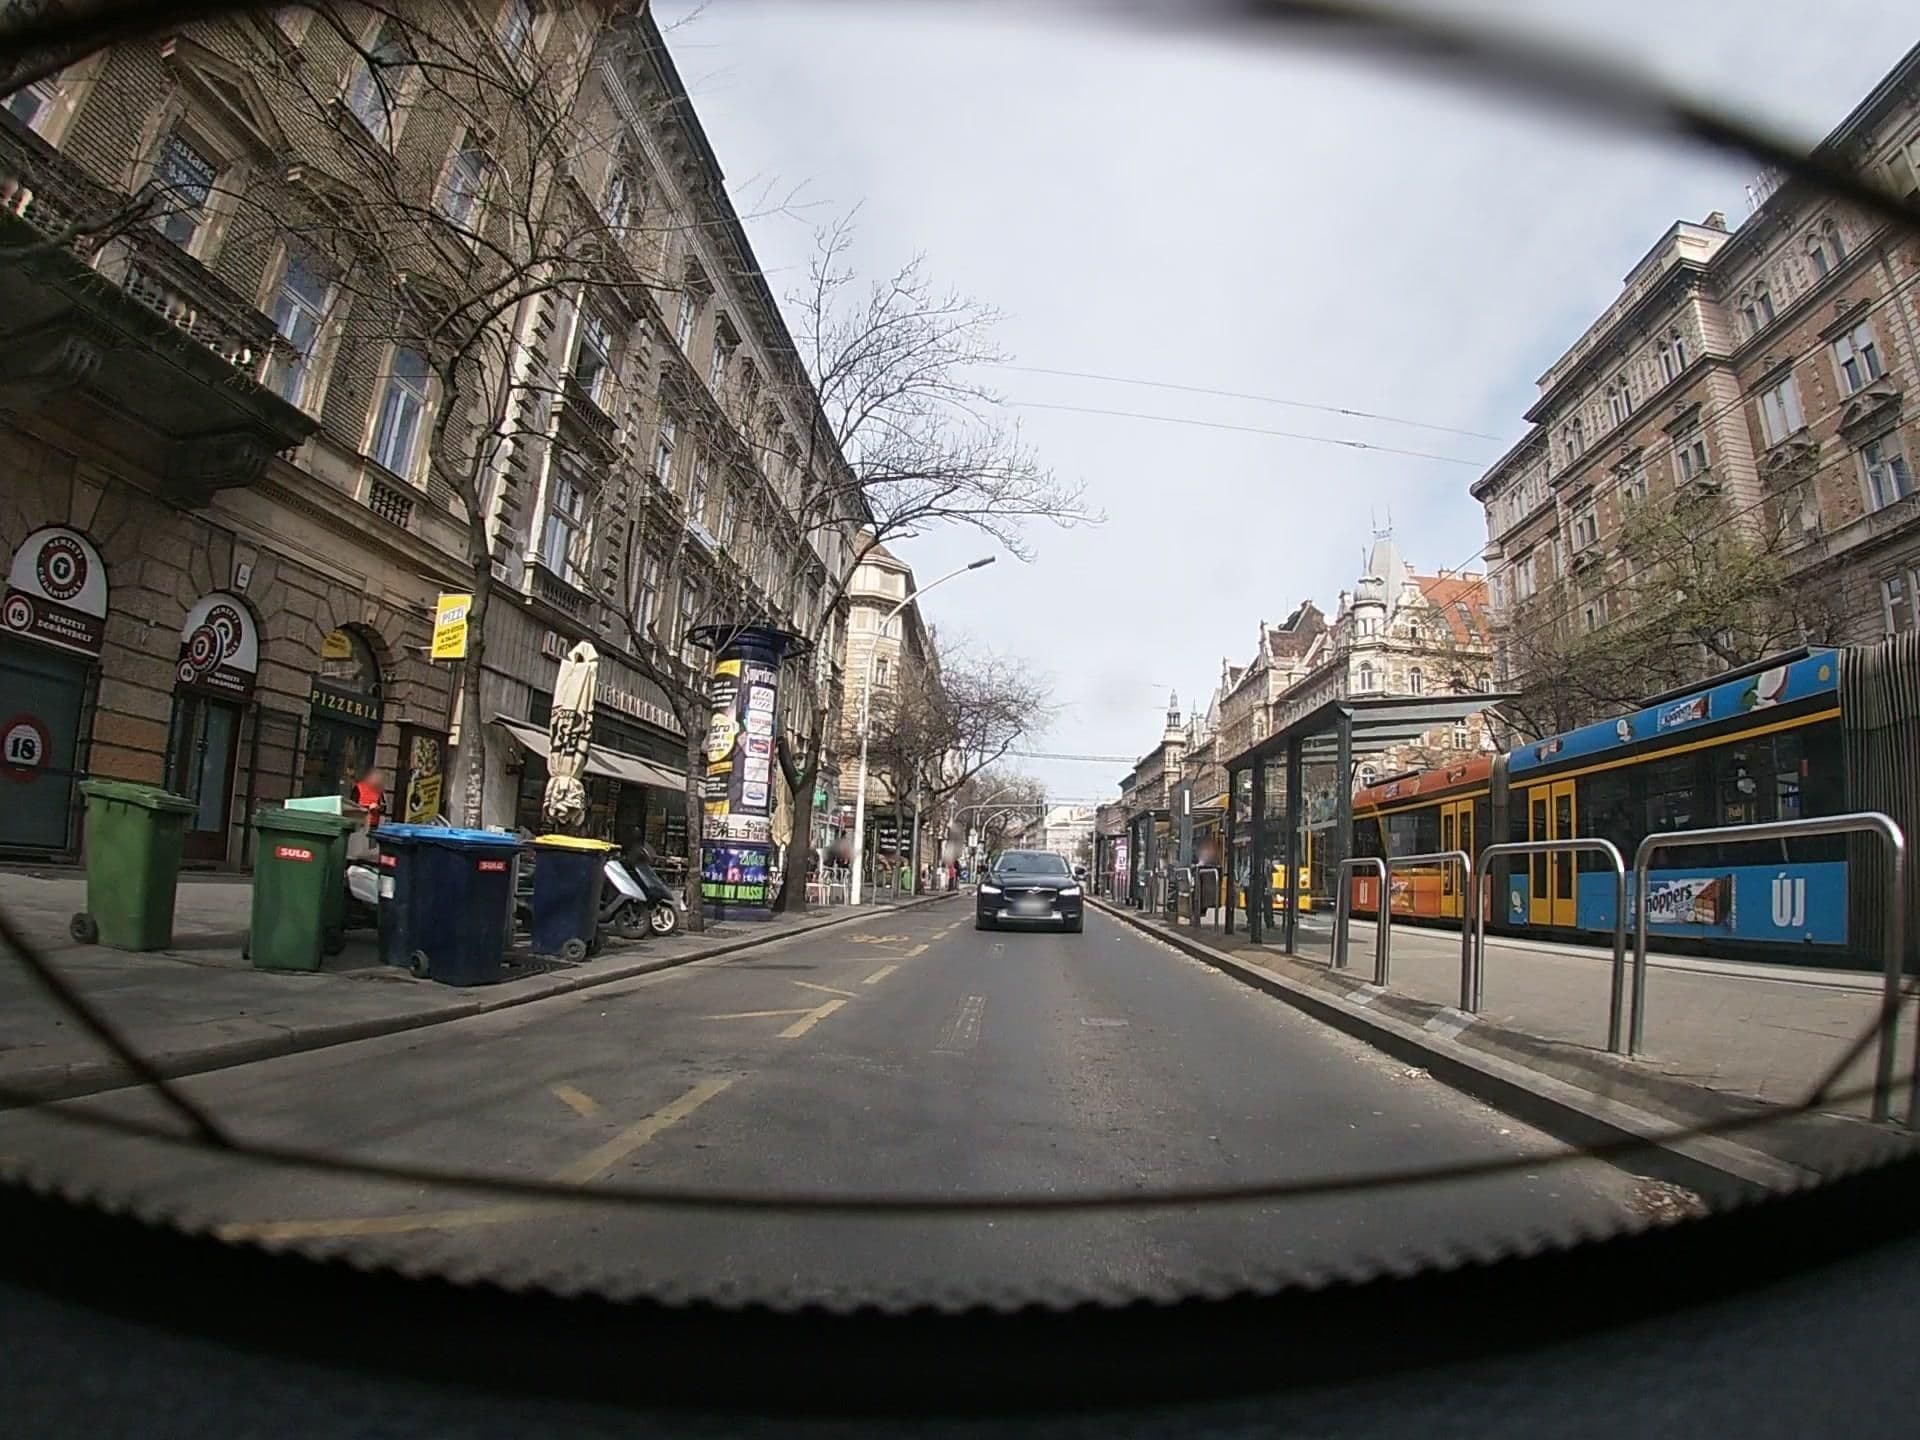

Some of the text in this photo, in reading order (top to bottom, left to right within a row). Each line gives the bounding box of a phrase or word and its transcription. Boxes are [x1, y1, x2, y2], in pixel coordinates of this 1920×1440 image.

[48, 613, 86, 631] NEMZETI
[311, 690, 378, 720] PIZZERIA
[11, 737, 35, 760] 18
[280, 847, 310, 859] SULO
[1646, 884, 1693, 914] noppers
[1772, 872, 1805, 927] ÚJ
